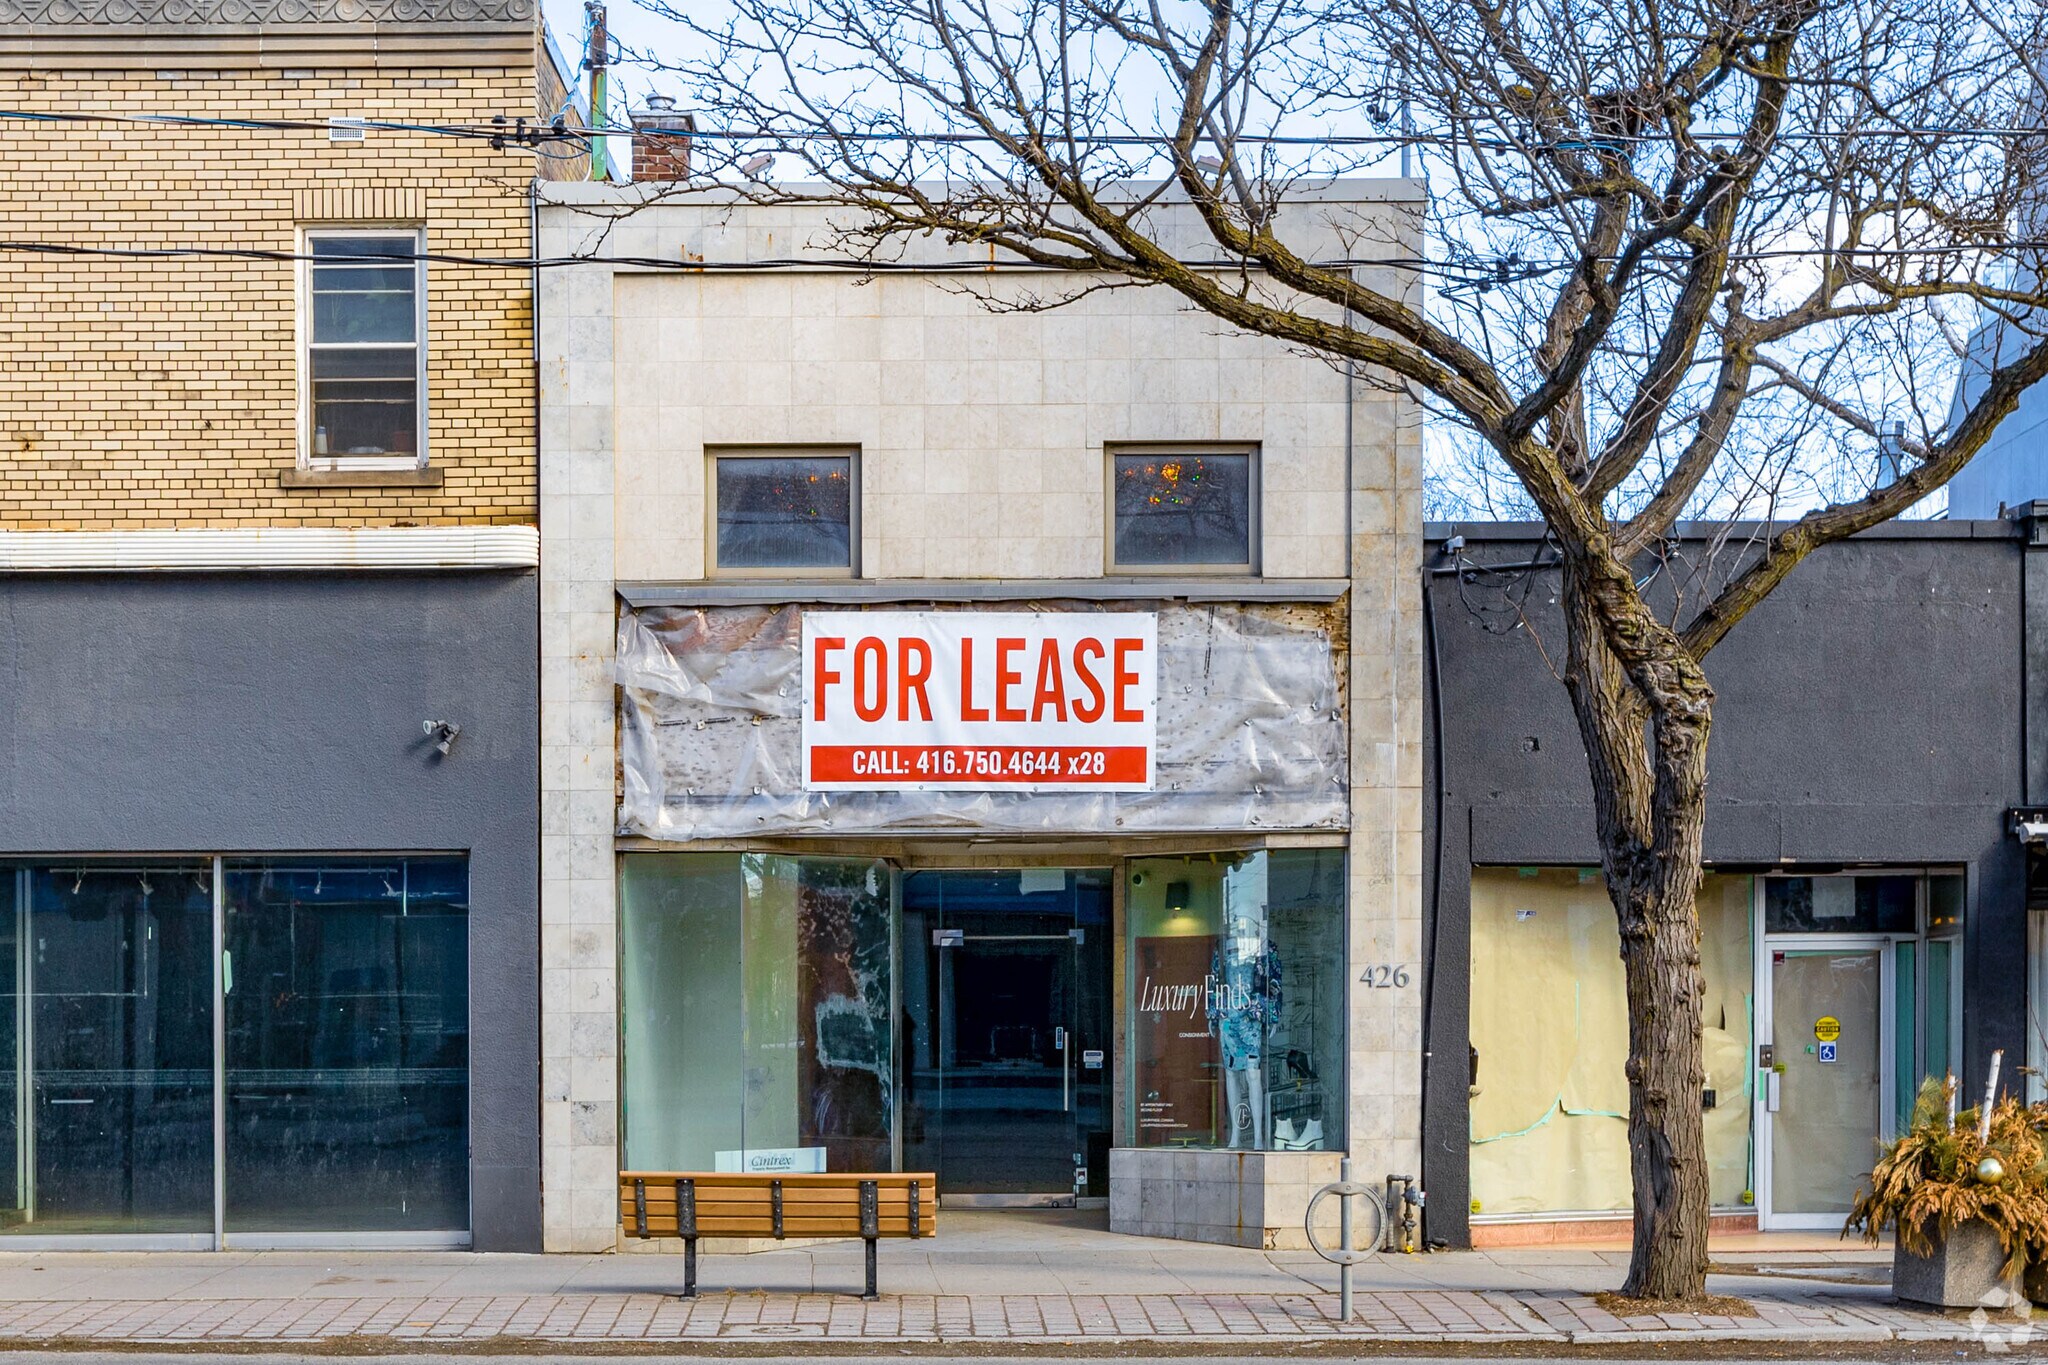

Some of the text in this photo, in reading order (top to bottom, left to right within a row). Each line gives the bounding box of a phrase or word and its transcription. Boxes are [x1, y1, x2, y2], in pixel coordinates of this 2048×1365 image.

[814, 636, 933, 723] FOR
[961, 636, 1144, 723] LEASE
[852, 750, 1106, 776] CALL: 416.750.4644 x28
[1359, 964, 1410, 988] 426
